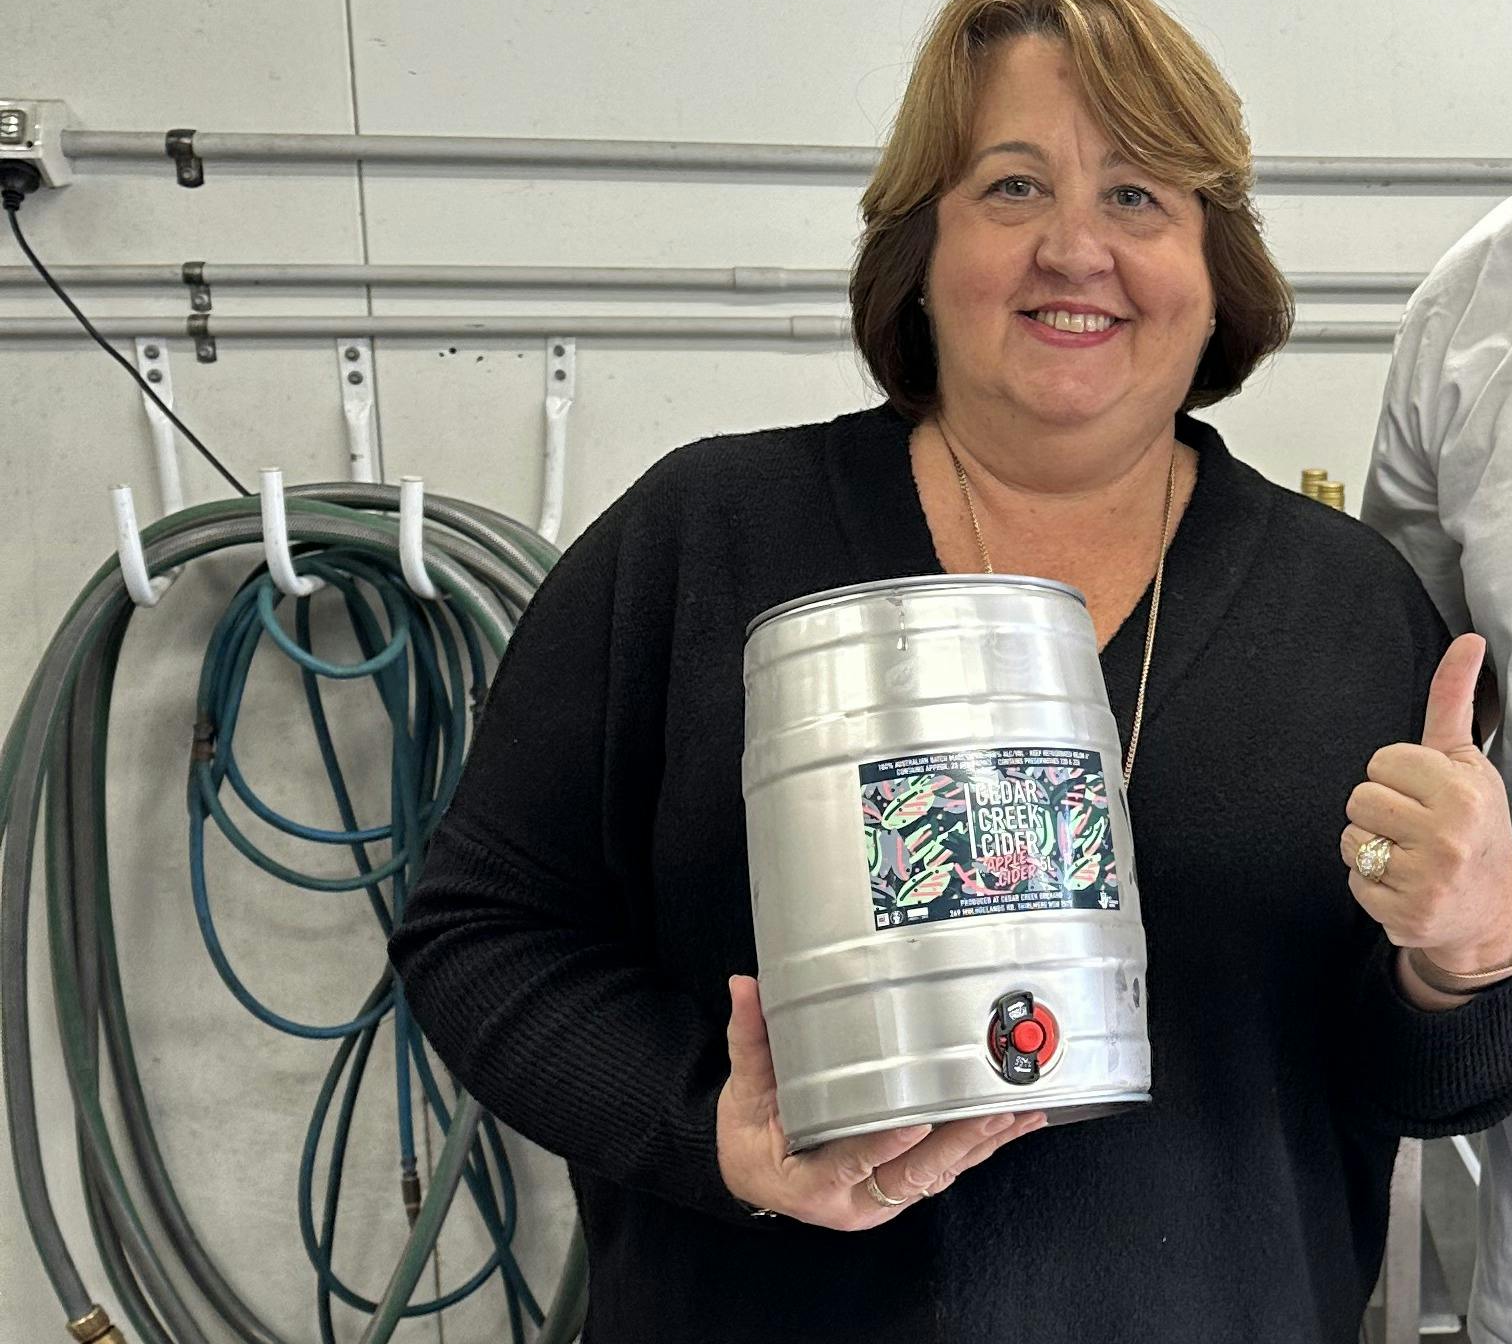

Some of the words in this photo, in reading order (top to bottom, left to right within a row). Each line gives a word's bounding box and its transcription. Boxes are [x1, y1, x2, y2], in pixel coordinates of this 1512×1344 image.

[975, 779, 1039, 806] CEDAR
[978, 803, 1042, 832] CREEK
[981, 830, 1040, 858] CIDER
[986, 848, 1028, 872] APPLE
[996, 864, 1036, 887] CIDER
